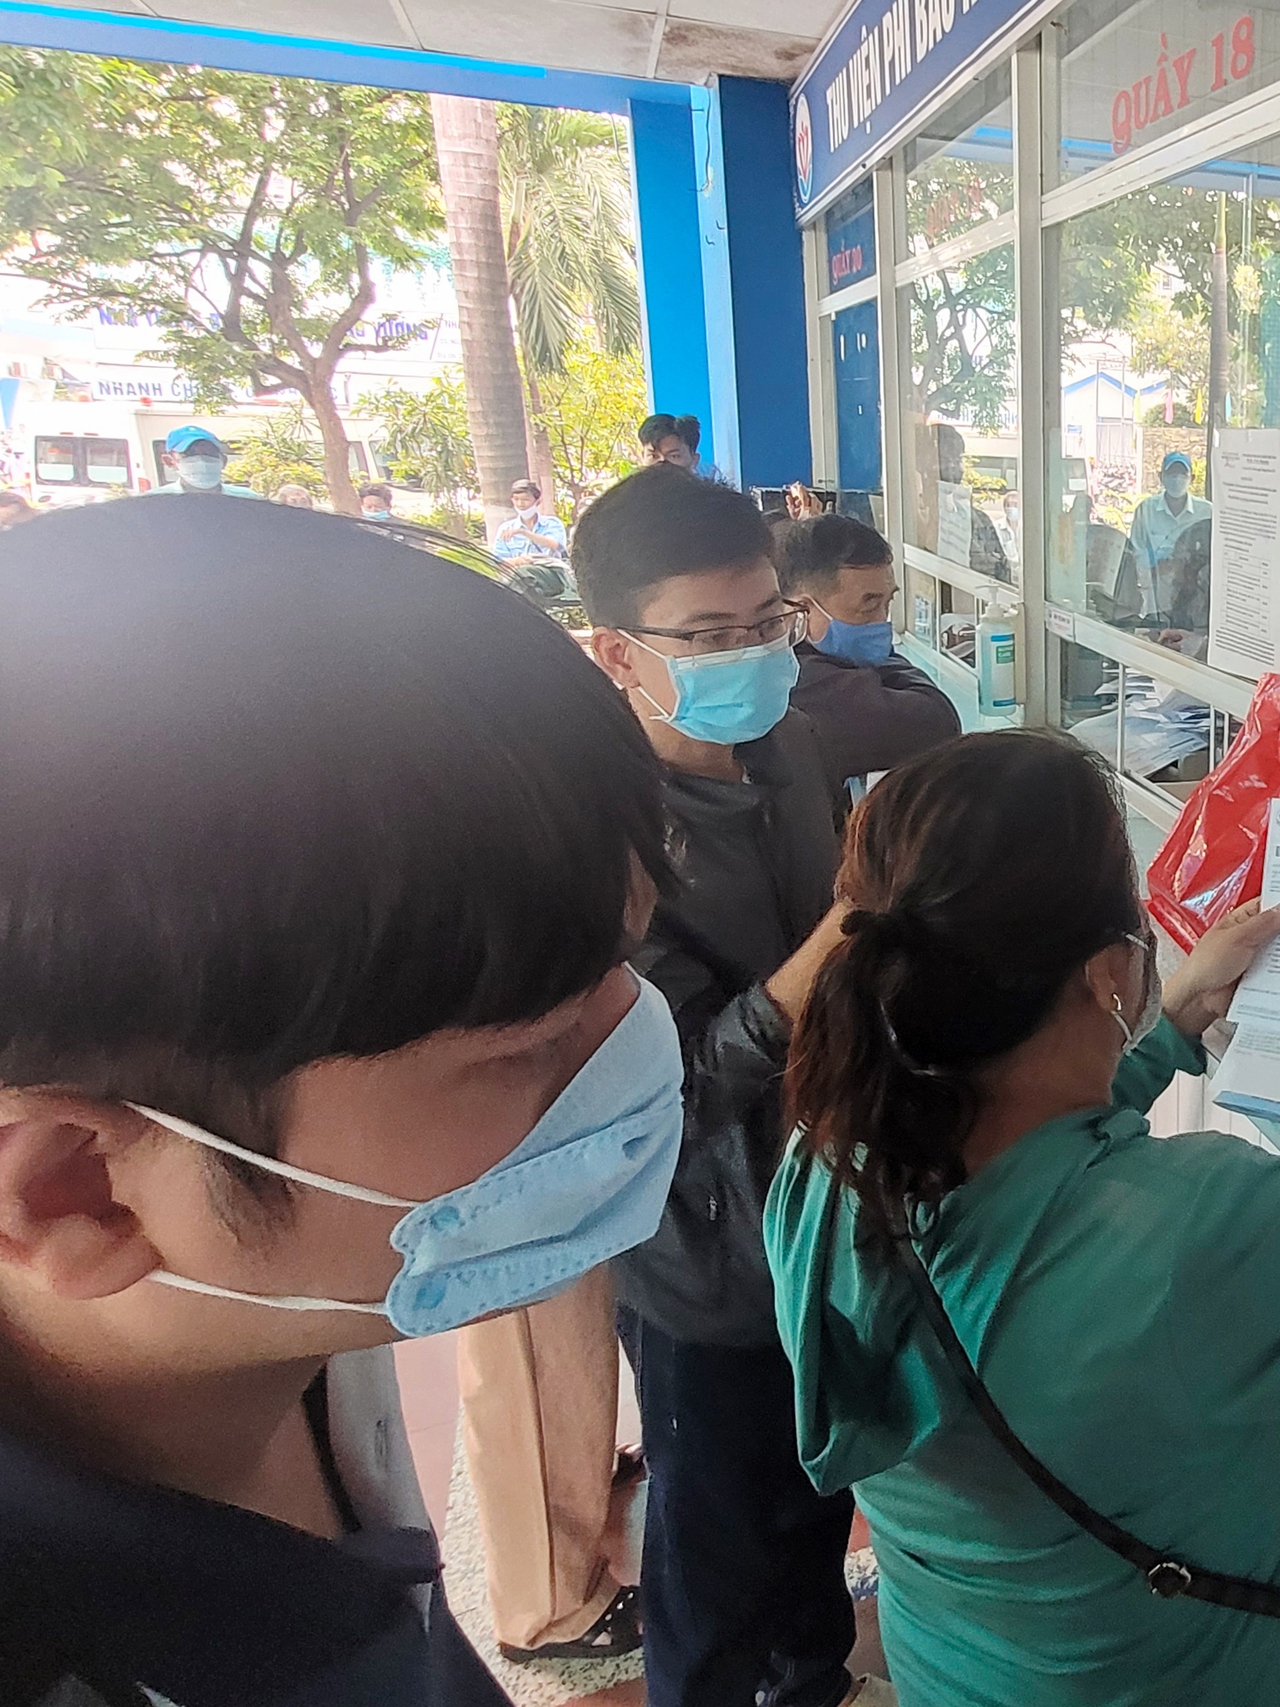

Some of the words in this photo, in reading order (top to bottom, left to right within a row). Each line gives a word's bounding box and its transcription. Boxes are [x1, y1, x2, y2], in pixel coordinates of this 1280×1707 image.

[826, 70, 850, 152] THU
[848, 25, 882, 134] VIỆN
[1111, 32, 1197, 155] QUẦY
[1210, 15, 1255, 92] 18
[98, 381, 163, 397] NHANH
